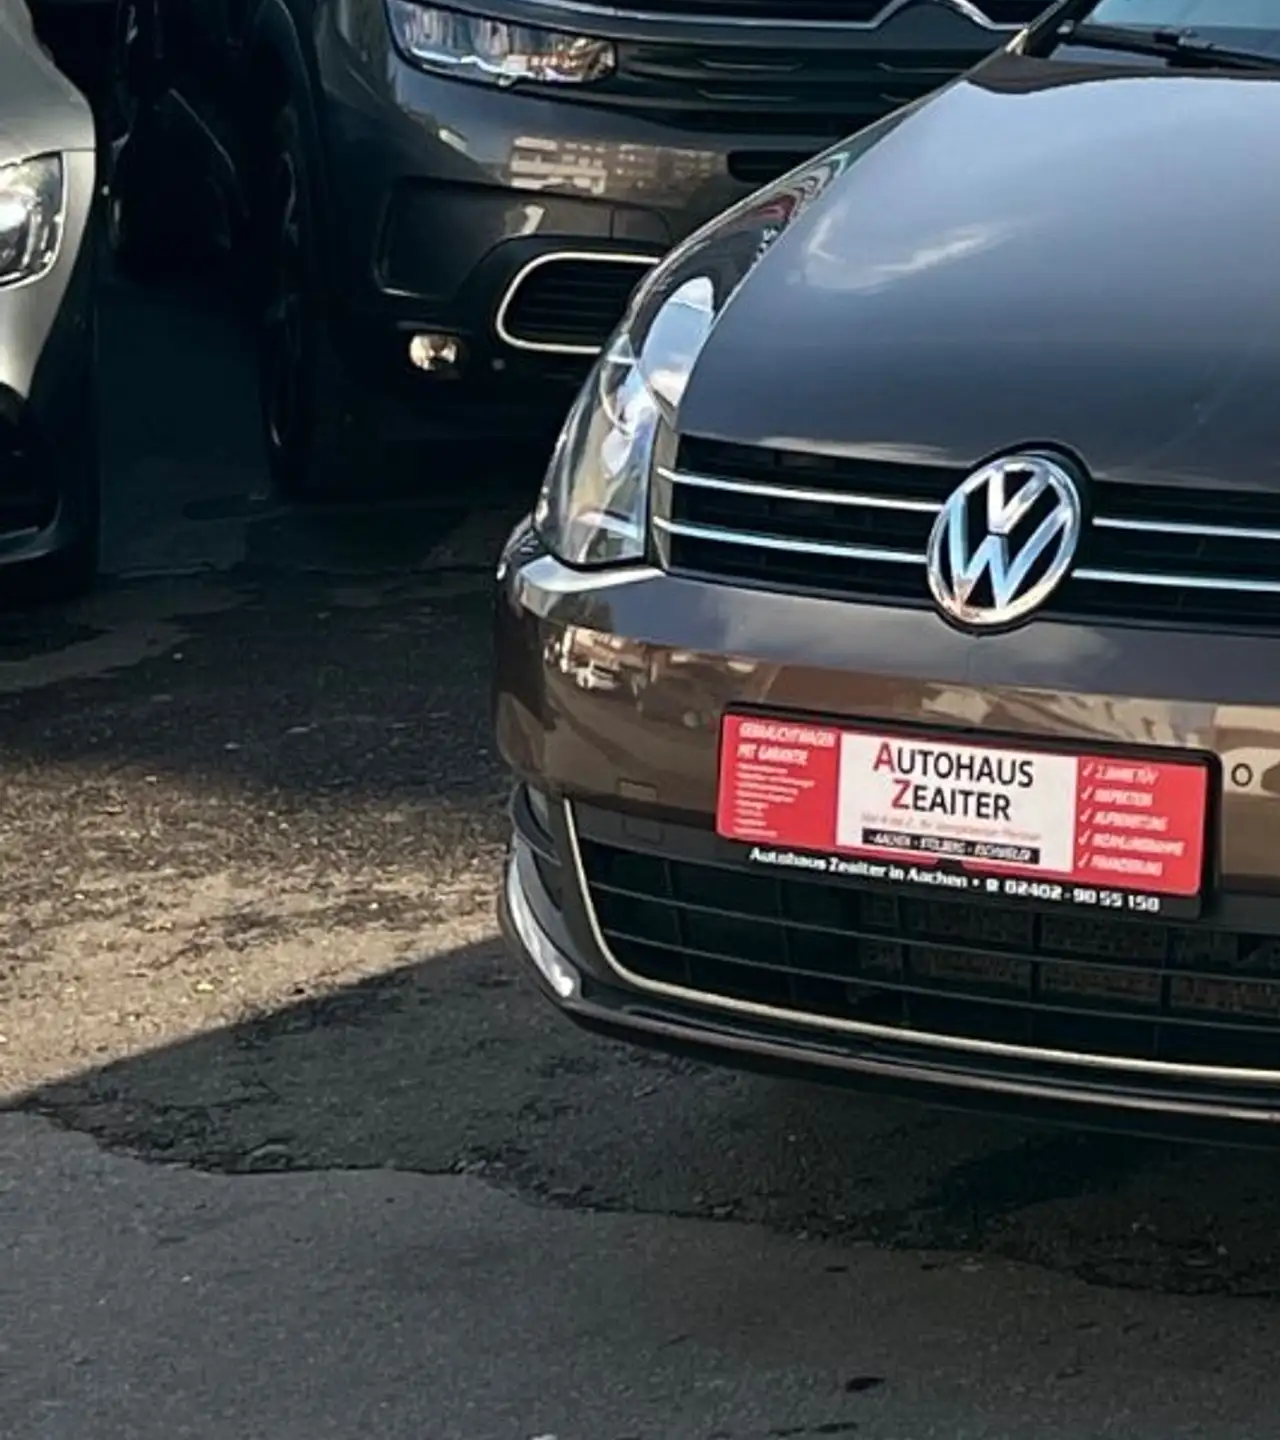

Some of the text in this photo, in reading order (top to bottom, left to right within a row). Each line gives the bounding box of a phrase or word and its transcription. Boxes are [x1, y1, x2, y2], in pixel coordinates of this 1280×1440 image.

[873, 741, 1033, 788] AUTOHAUS
[891, 779, 1012, 822] ZEAITER
[749, 847, 1161, 913] Autohaus Zeaiter in Aachen 02402 90 55 150
